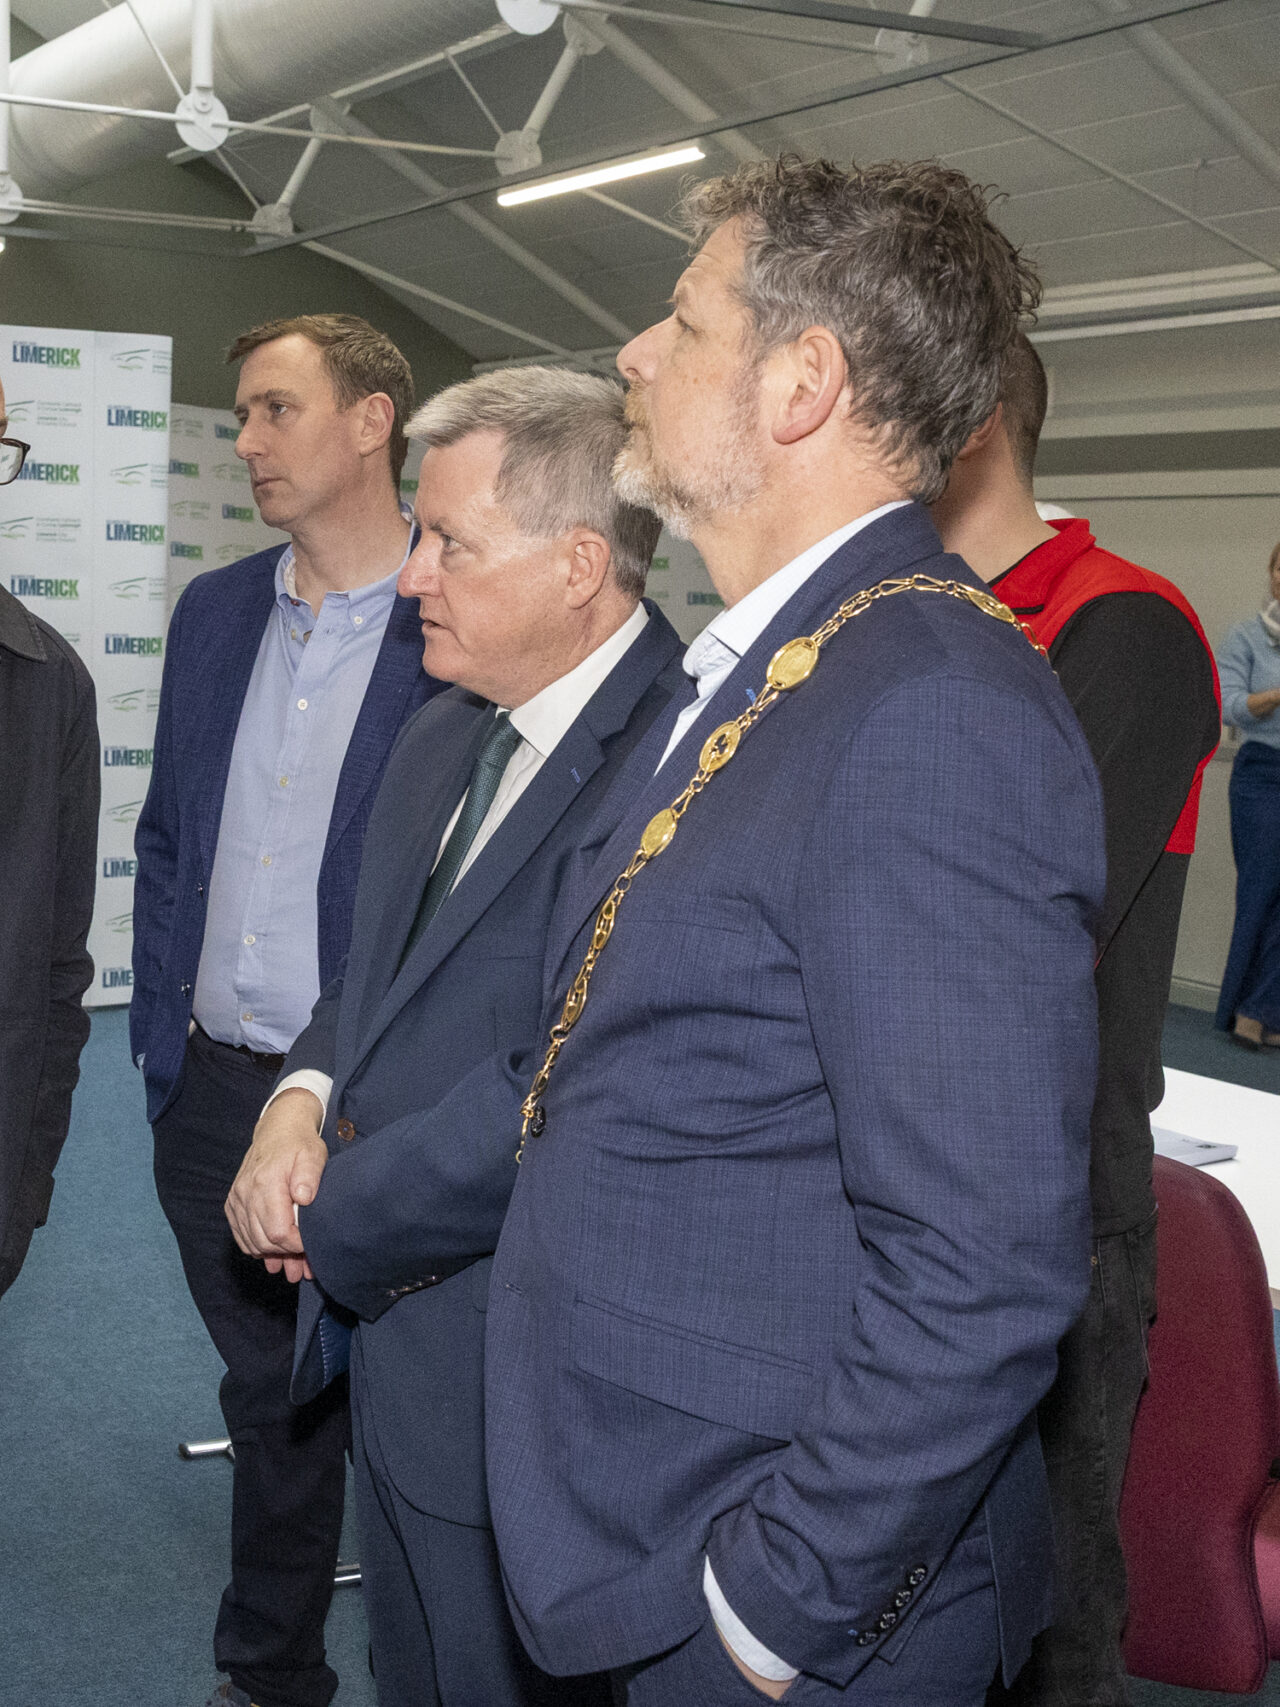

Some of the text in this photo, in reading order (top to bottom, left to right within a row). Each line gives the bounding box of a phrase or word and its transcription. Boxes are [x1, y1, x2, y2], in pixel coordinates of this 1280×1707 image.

[12, 344, 81, 367] LIMERICK
[107, 408, 168, 429] LIMERICK
[19, 462, 80, 483] IMERICK
[106, 523, 166, 542] LIMERICK
[11, 578, 79, 598] LIMERICK
[105, 637, 162, 655] LIMERICK
